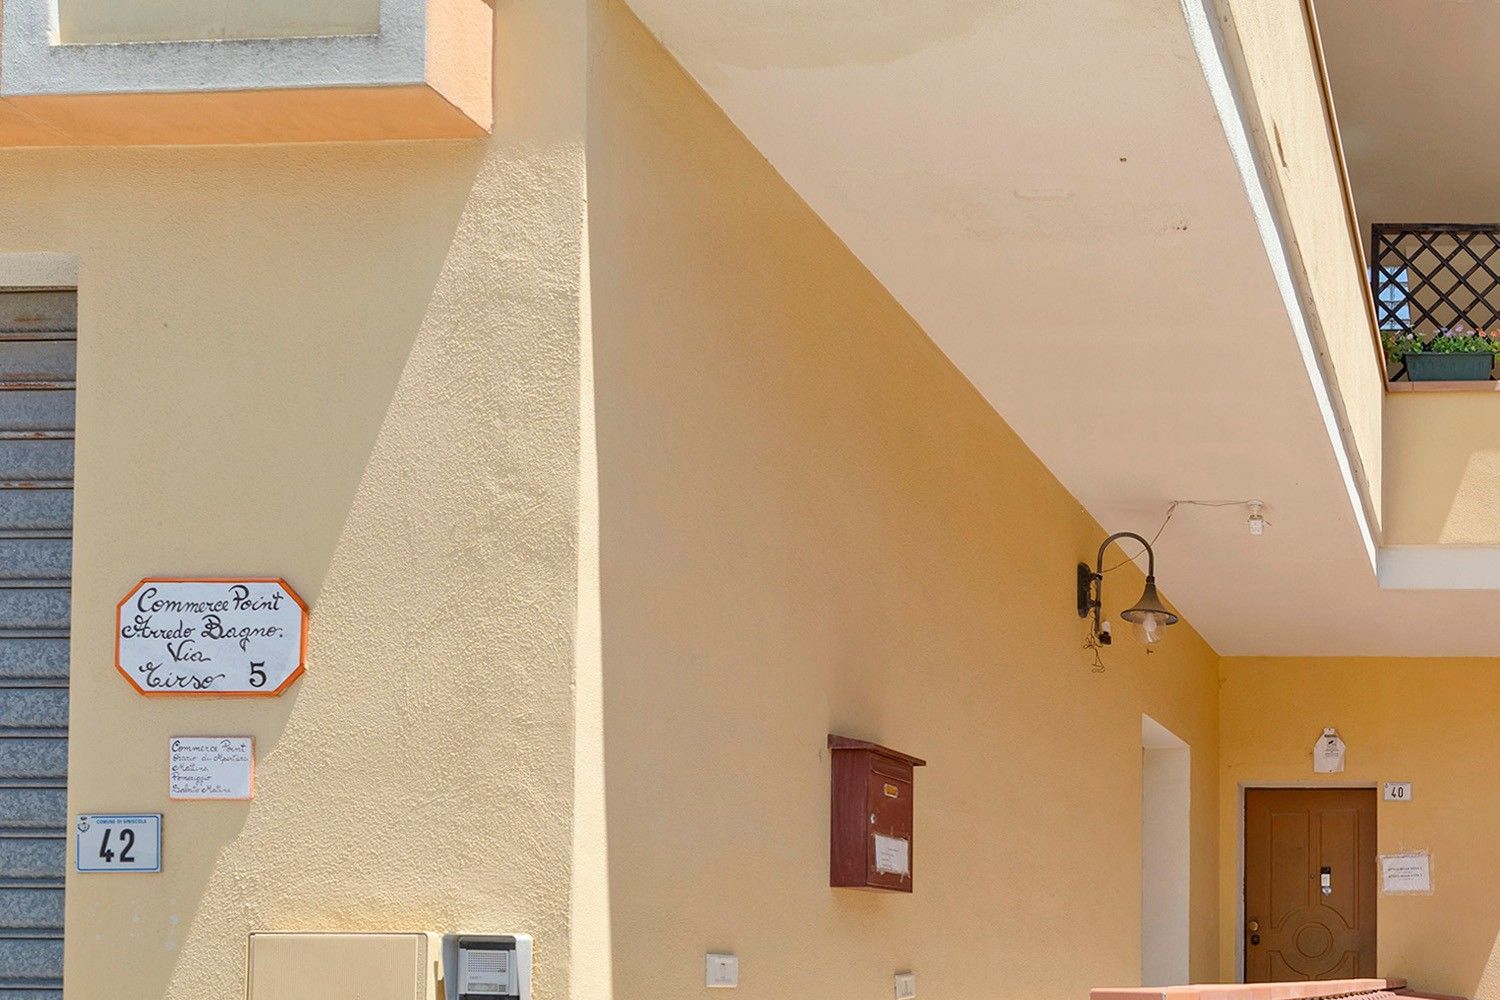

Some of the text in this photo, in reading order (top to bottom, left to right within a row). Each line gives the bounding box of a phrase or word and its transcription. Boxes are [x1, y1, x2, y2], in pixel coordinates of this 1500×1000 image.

[137, 584, 284, 613] Commerce Point
[121, 615, 196, 640] Arredo
[167, 639, 211, 662] Via
[139, 660, 267, 690] Tirso 5
[1391, 786, 1404, 798] 40
[99, 828, 135, 863] 42
